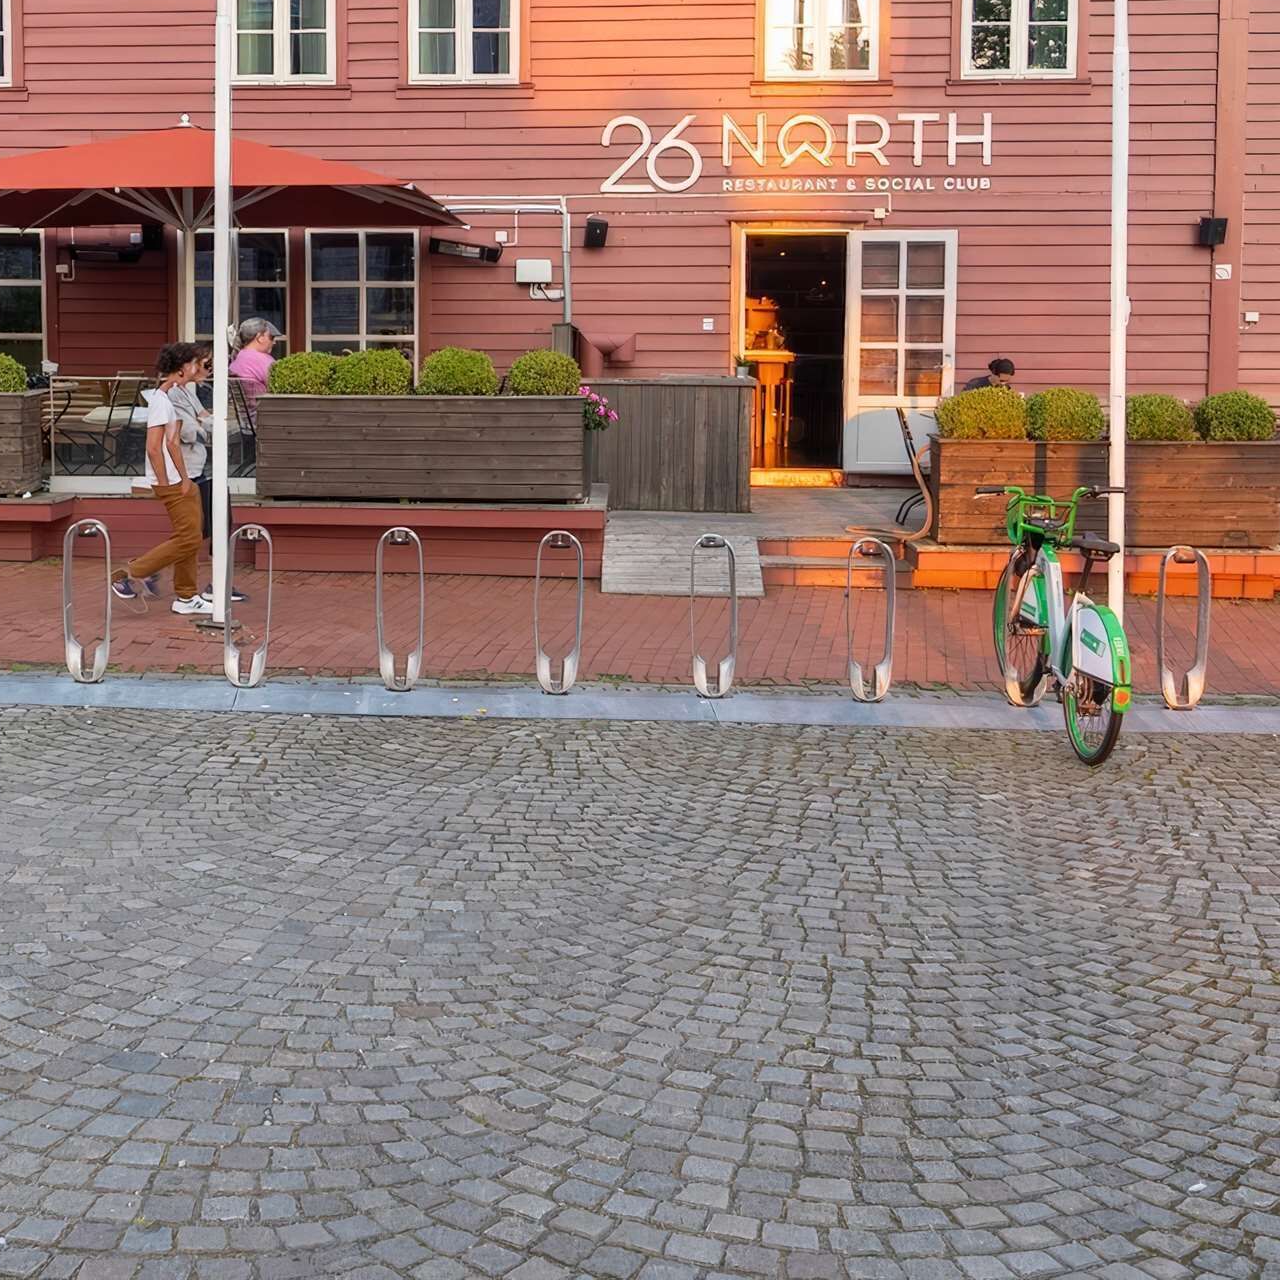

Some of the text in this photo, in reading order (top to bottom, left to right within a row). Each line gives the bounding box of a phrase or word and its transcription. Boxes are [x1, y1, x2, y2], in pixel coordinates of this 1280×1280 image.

[599, 112, 993, 194] 26 NORTH
[721, 177, 992, 192] RESTAURANT & SOCIAL CLUB
